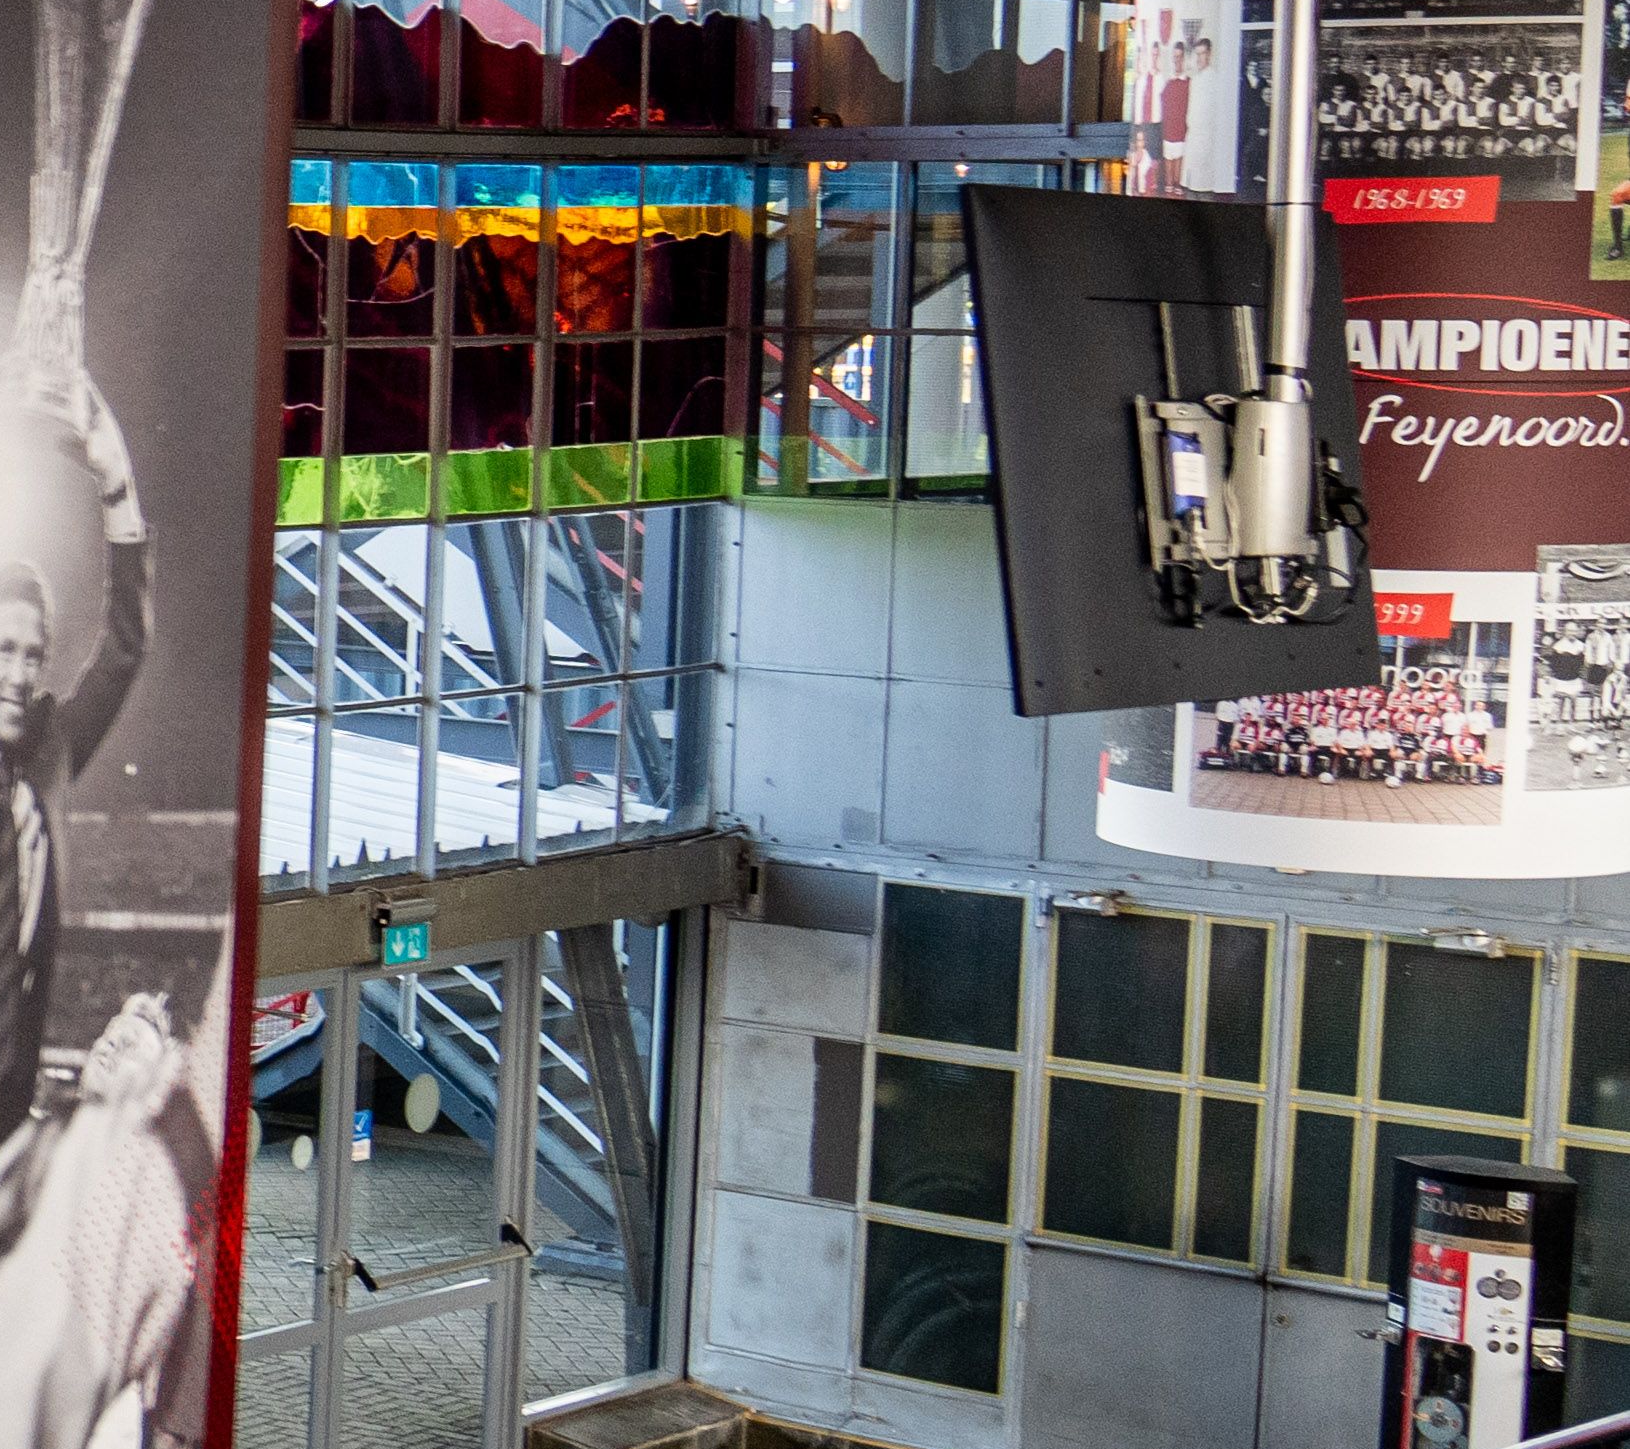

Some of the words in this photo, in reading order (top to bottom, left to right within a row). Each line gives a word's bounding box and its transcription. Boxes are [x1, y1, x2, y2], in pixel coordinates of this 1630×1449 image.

[1353, 187, 1467, 210] 1968-1969
[1358, 394, 1630, 483] Feyenoord.
[1419, 1195, 1526, 1226] SOUVENIRS
